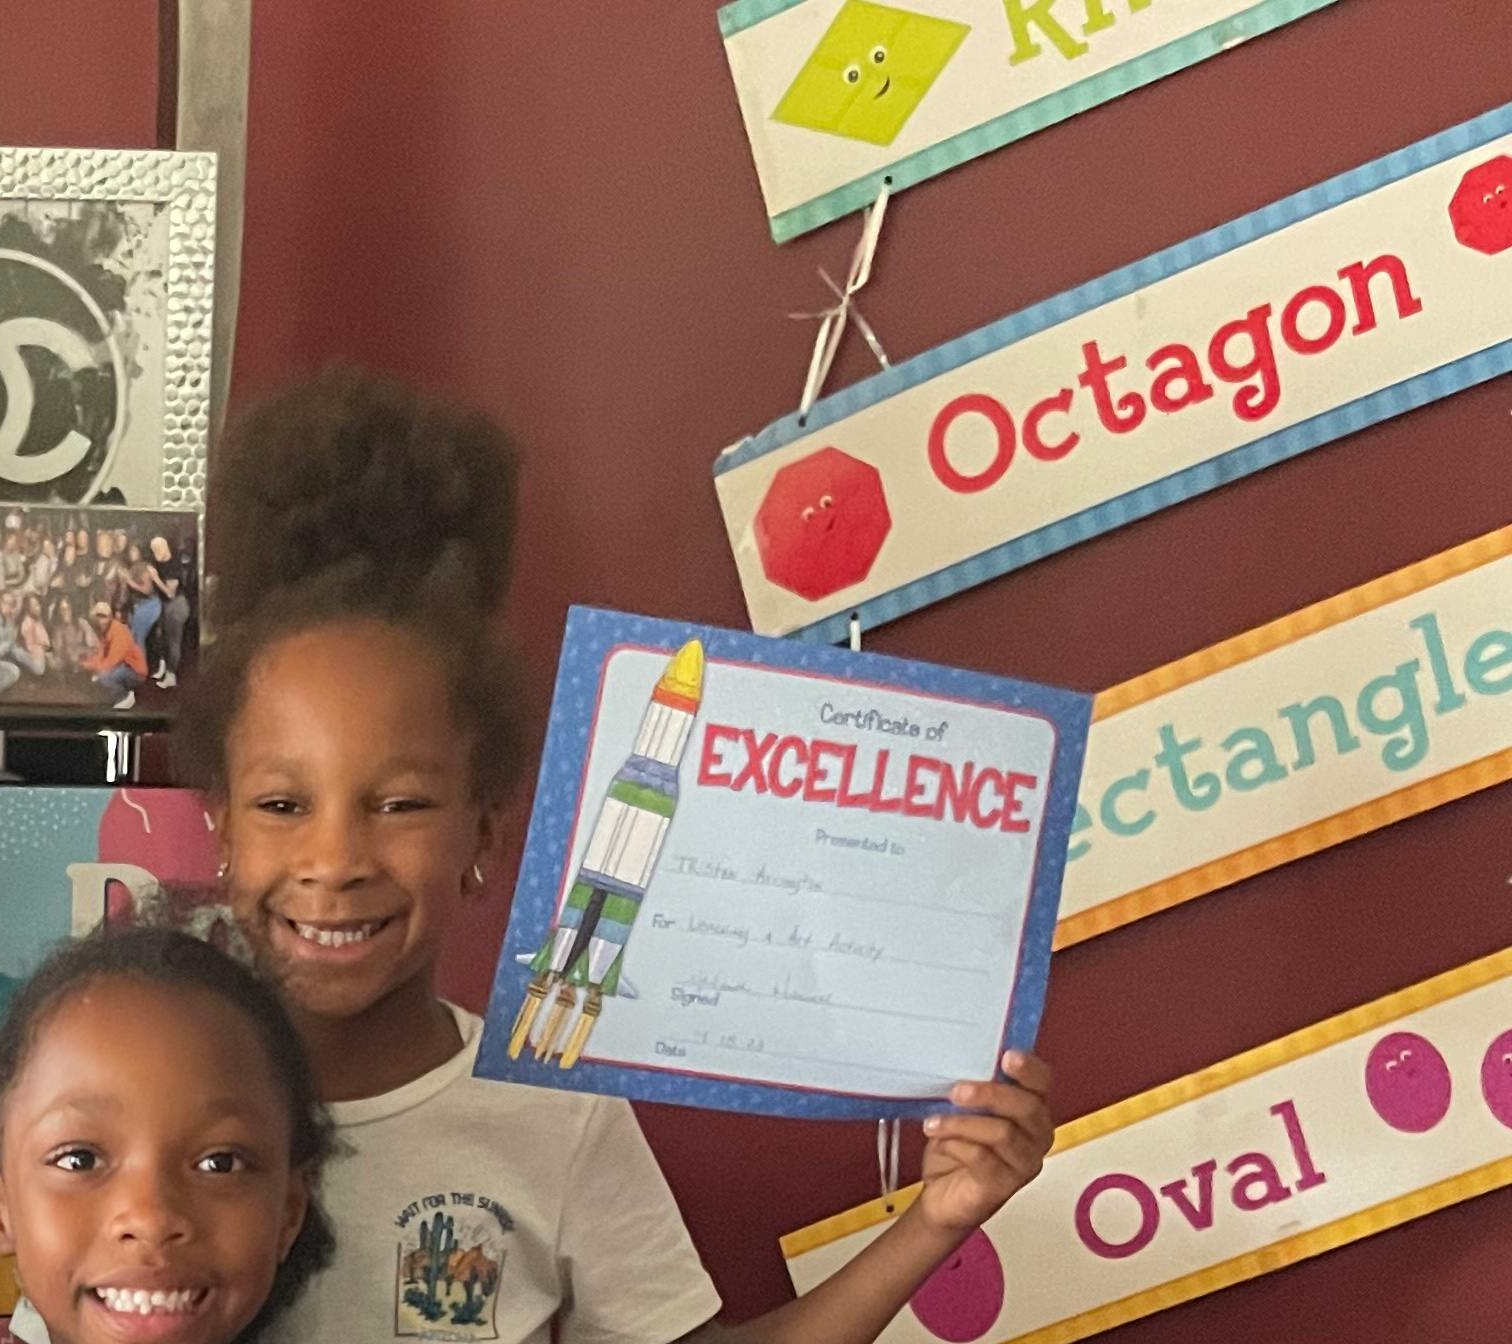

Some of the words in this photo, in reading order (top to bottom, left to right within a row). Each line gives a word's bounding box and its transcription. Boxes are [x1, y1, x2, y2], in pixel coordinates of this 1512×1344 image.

[927, 252, 1424, 496] Octagon
[820, 703, 921, 738] Certificate
[925, 721, 950, 743] of
[696, 722, 1038, 834] EXCELLENCE
[815, 828, 888, 855] Presented
[889, 841, 906, 857] to
[652, 913, 676, 929] For
[670, 986, 721, 1008] Signed
[654, 1040, 688, 1058] Date
[1074, 1099, 1327, 1259] Oval
[450, 1191, 475, 1207] THE
